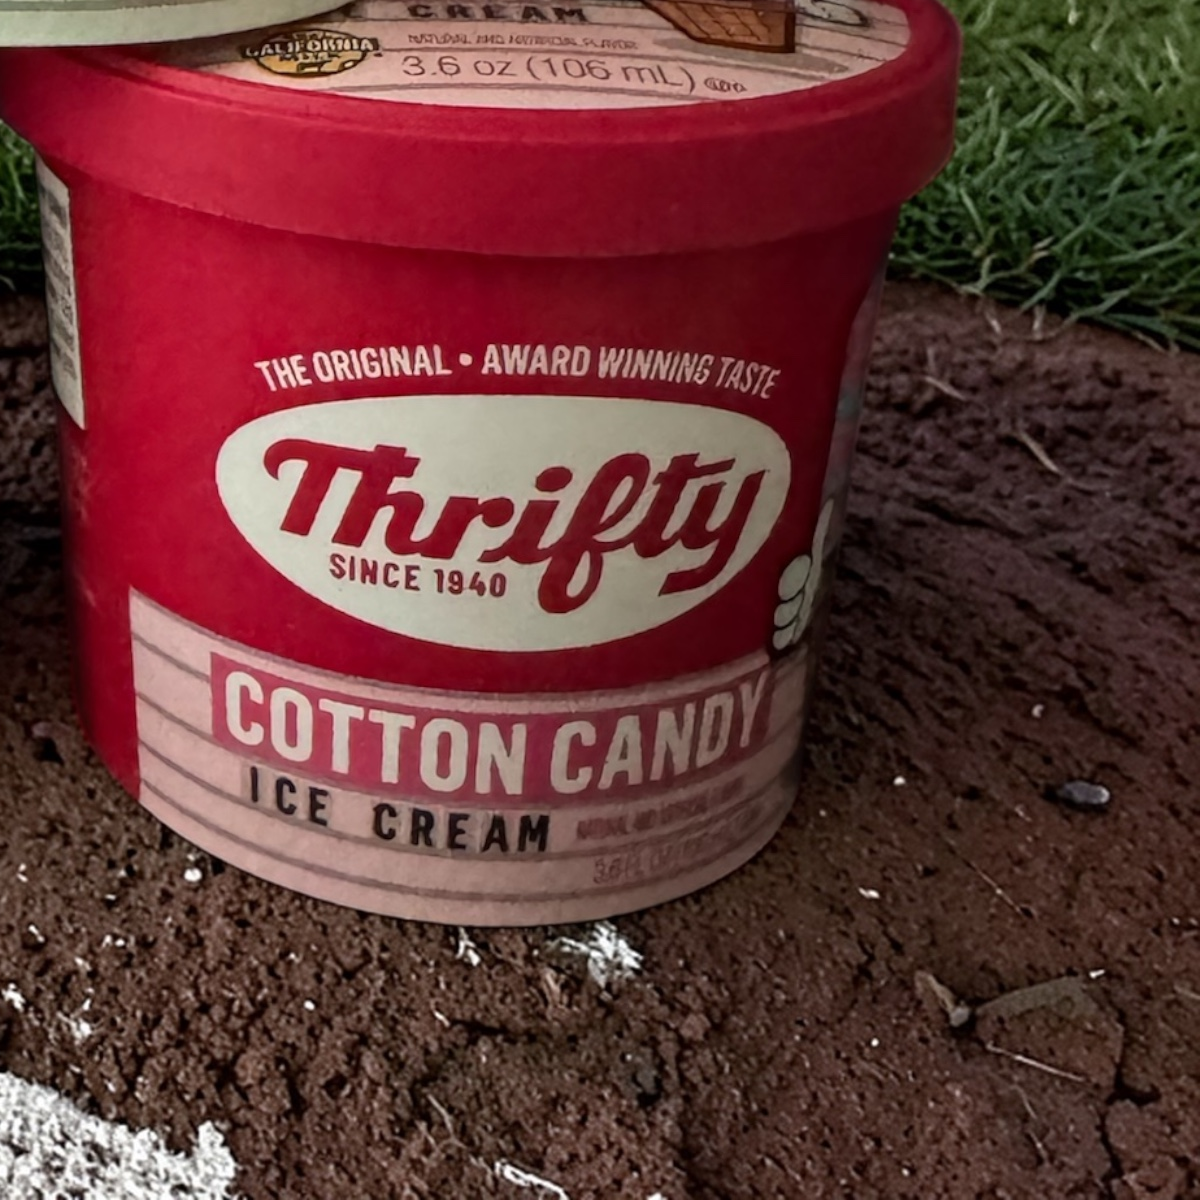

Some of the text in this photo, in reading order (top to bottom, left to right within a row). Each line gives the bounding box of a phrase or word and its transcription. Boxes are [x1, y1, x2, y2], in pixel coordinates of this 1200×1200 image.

[403, 56, 460, 76] 3.6
[526, 55, 611, 81] (106
[622, 64, 697, 94] mL)
[254, 344, 781, 400] THE ORIGINAL AWARD WINNING TASTE
[263, 438, 770, 614] Thrifty
[330, 554, 506, 598] SINCE 1940
[225, 669, 771, 795] COTTON CANDY
[248, 765, 329, 827] ICE
[373, 803, 550, 853] CREAM
